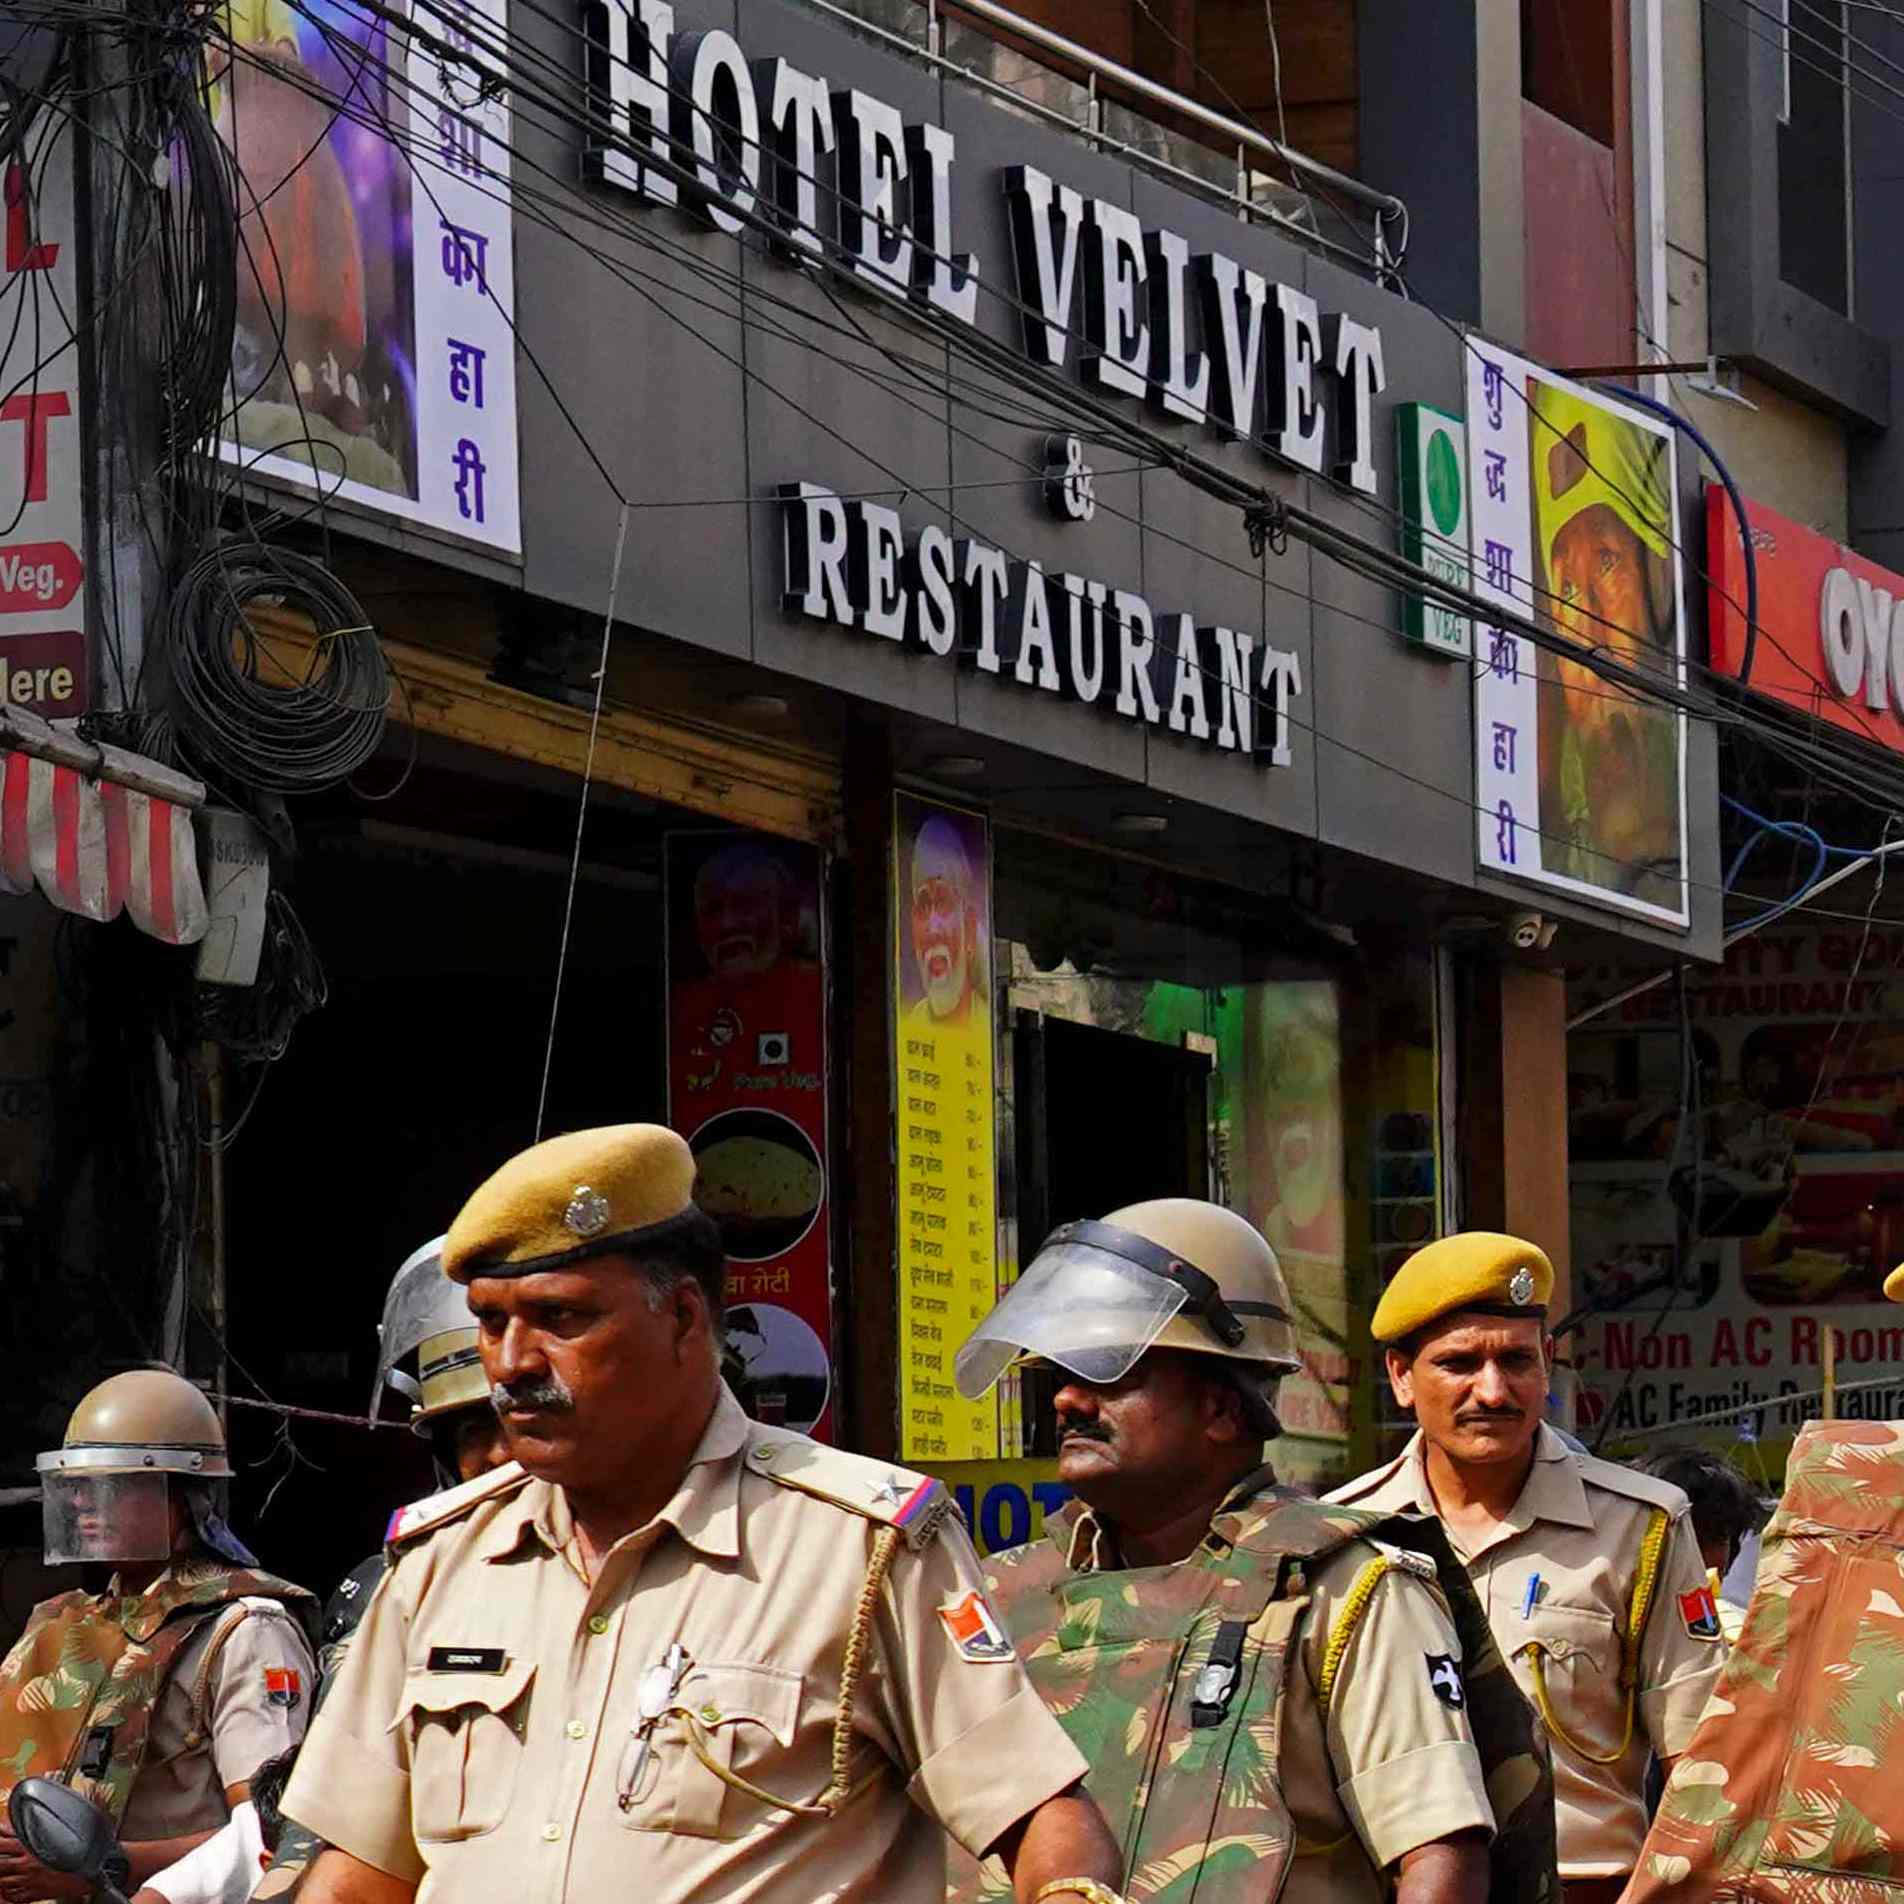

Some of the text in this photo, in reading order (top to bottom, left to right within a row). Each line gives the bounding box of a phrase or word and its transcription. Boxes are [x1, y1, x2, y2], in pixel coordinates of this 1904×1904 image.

[603, 0, 1386, 495] HOTEL VELVET
[1062, 435, 1095, 521] &
[801, 481, 1303, 767] RESTAURANT
[1710, 1316, 1772, 1368] AC
[1615, 1381, 1662, 1429] AC
[1669, 1378, 1765, 1433] Family
